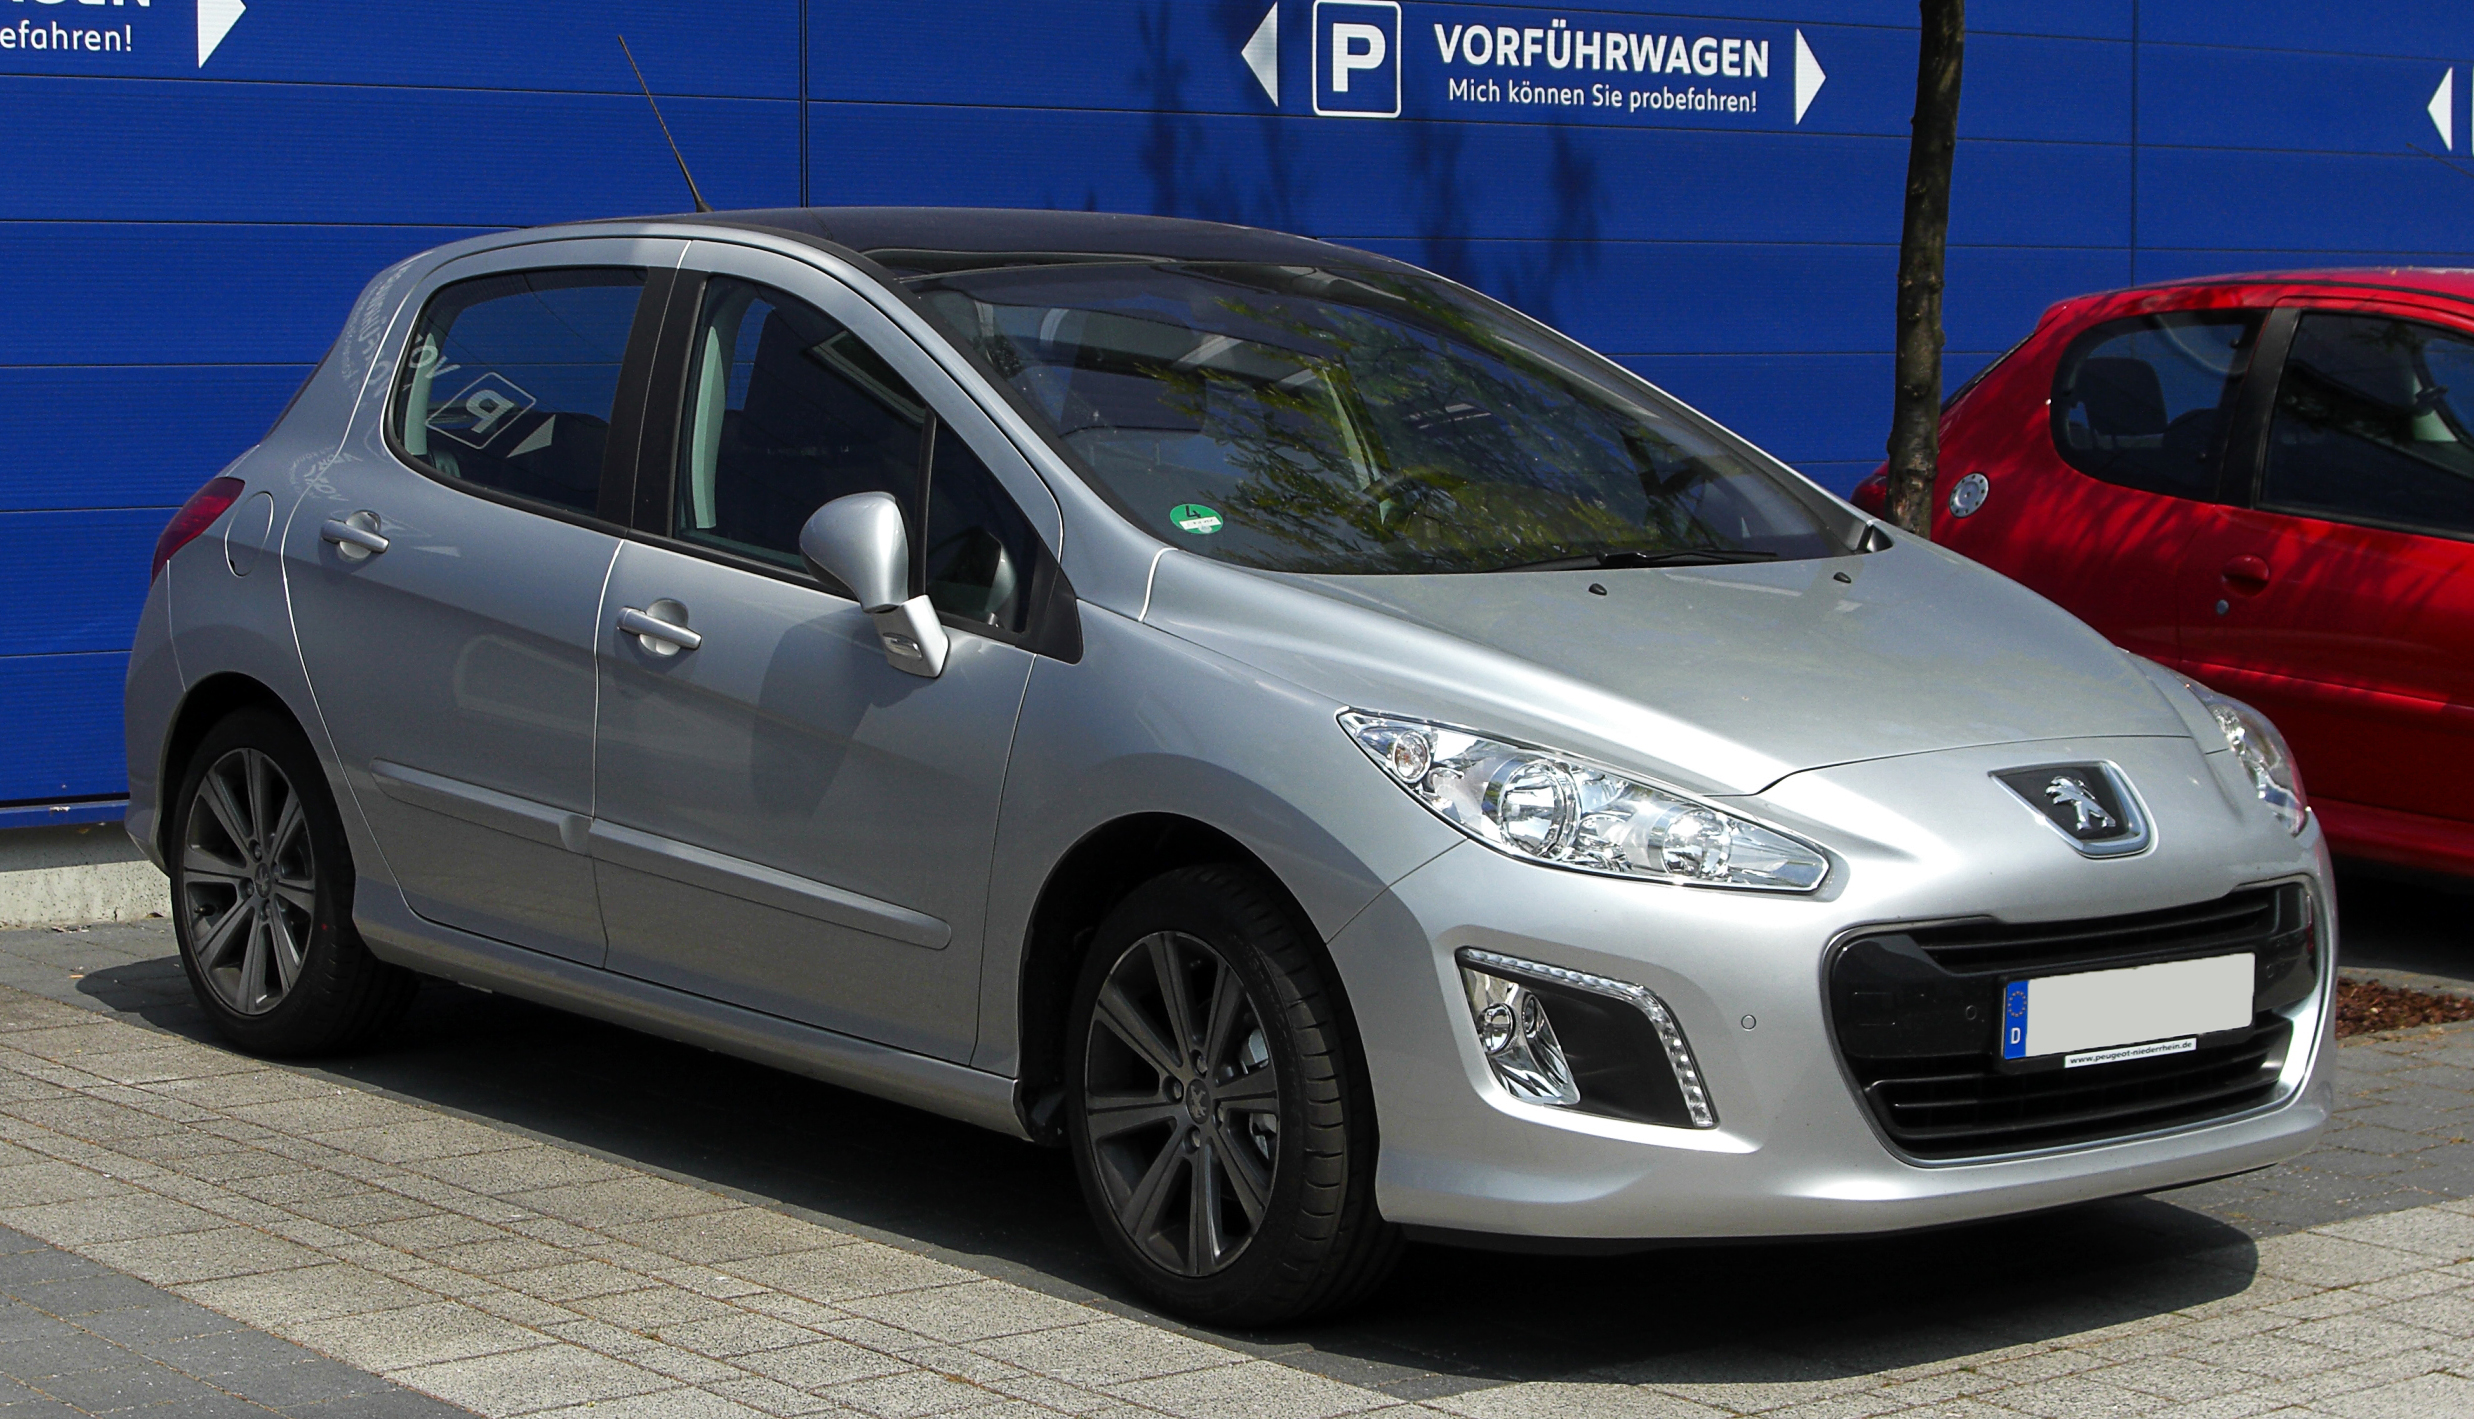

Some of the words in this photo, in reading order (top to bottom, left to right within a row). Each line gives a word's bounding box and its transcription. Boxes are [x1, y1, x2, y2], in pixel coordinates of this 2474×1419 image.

[0, 20, 131, 51] efahren!
[1434, 19, 1768, 78] VORFÜHRWAGEN
[1333, 23, 1385, 92] P
[1450, 78, 1500, 102] Mich
[1509, 79, 1584, 105] können
[1593, 84, 1622, 107] Sie
[1630, 86, 1756, 112] probefahren!
[2010, 1027, 2021, 1045] D
[2070, 1041, 2192, 1063] www.peugeot-niederrhein.de
